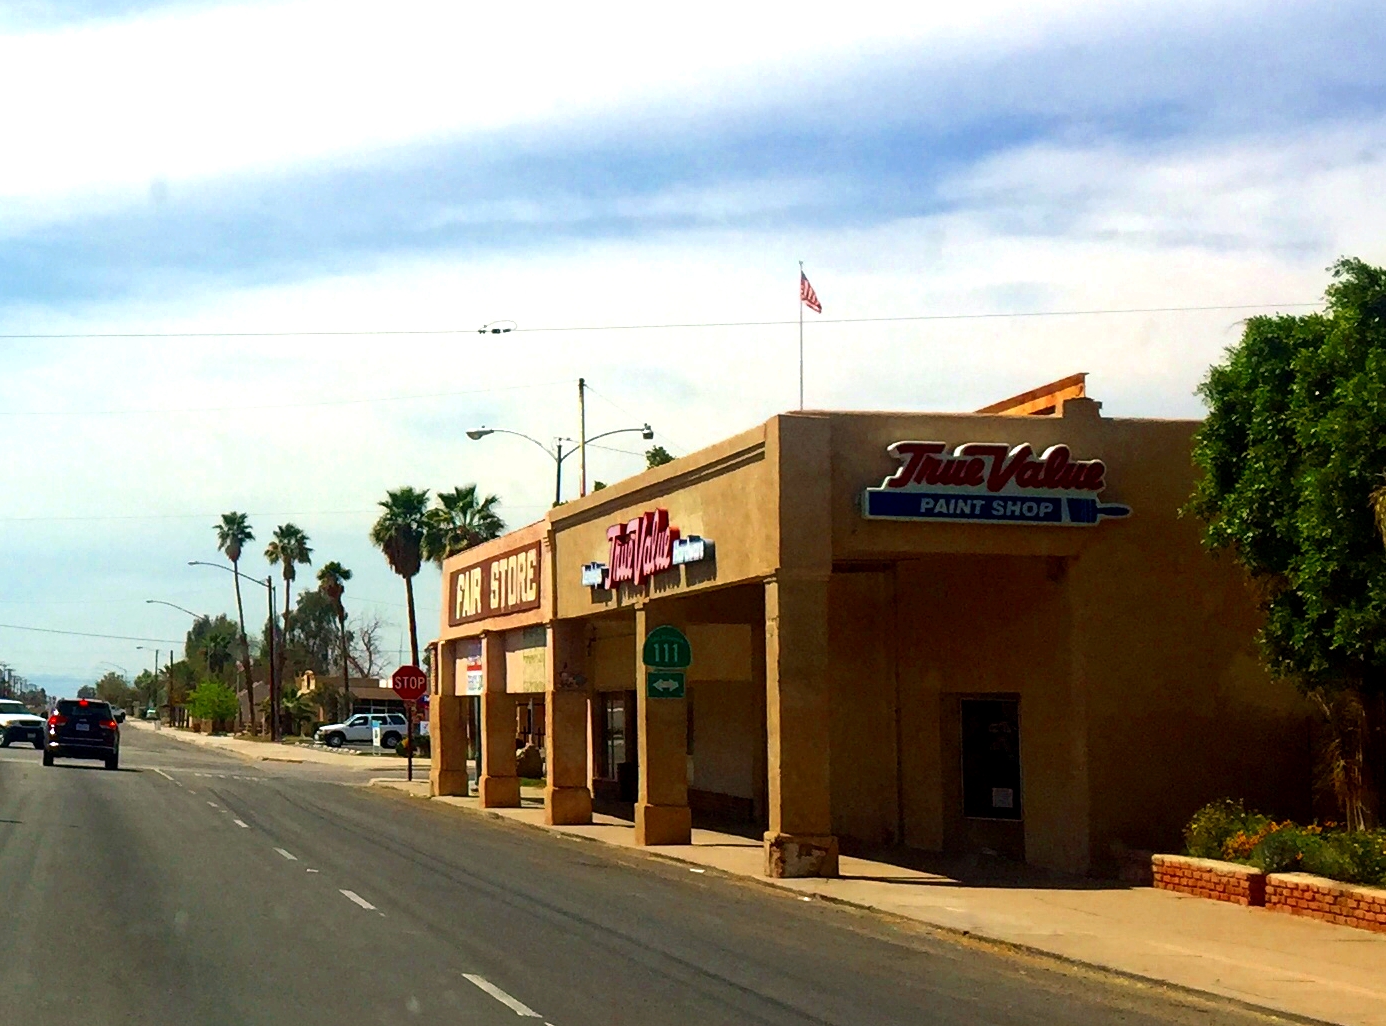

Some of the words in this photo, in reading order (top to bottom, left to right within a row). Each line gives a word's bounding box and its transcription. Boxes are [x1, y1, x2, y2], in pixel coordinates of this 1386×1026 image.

[887, 441, 986, 489] True
[954, 442, 1107, 492] Value
[920, 498, 985, 516] PAINT
[991, 500, 1054, 518] SHOP
[604, 523, 636, 590] True
[626, 508, 672, 586] Value
[456, 565, 482, 619] FAIR
[490, 549, 537, 610] STORE
[654, 643, 678, 662] 111
[394, 676, 425, 689] STOP
